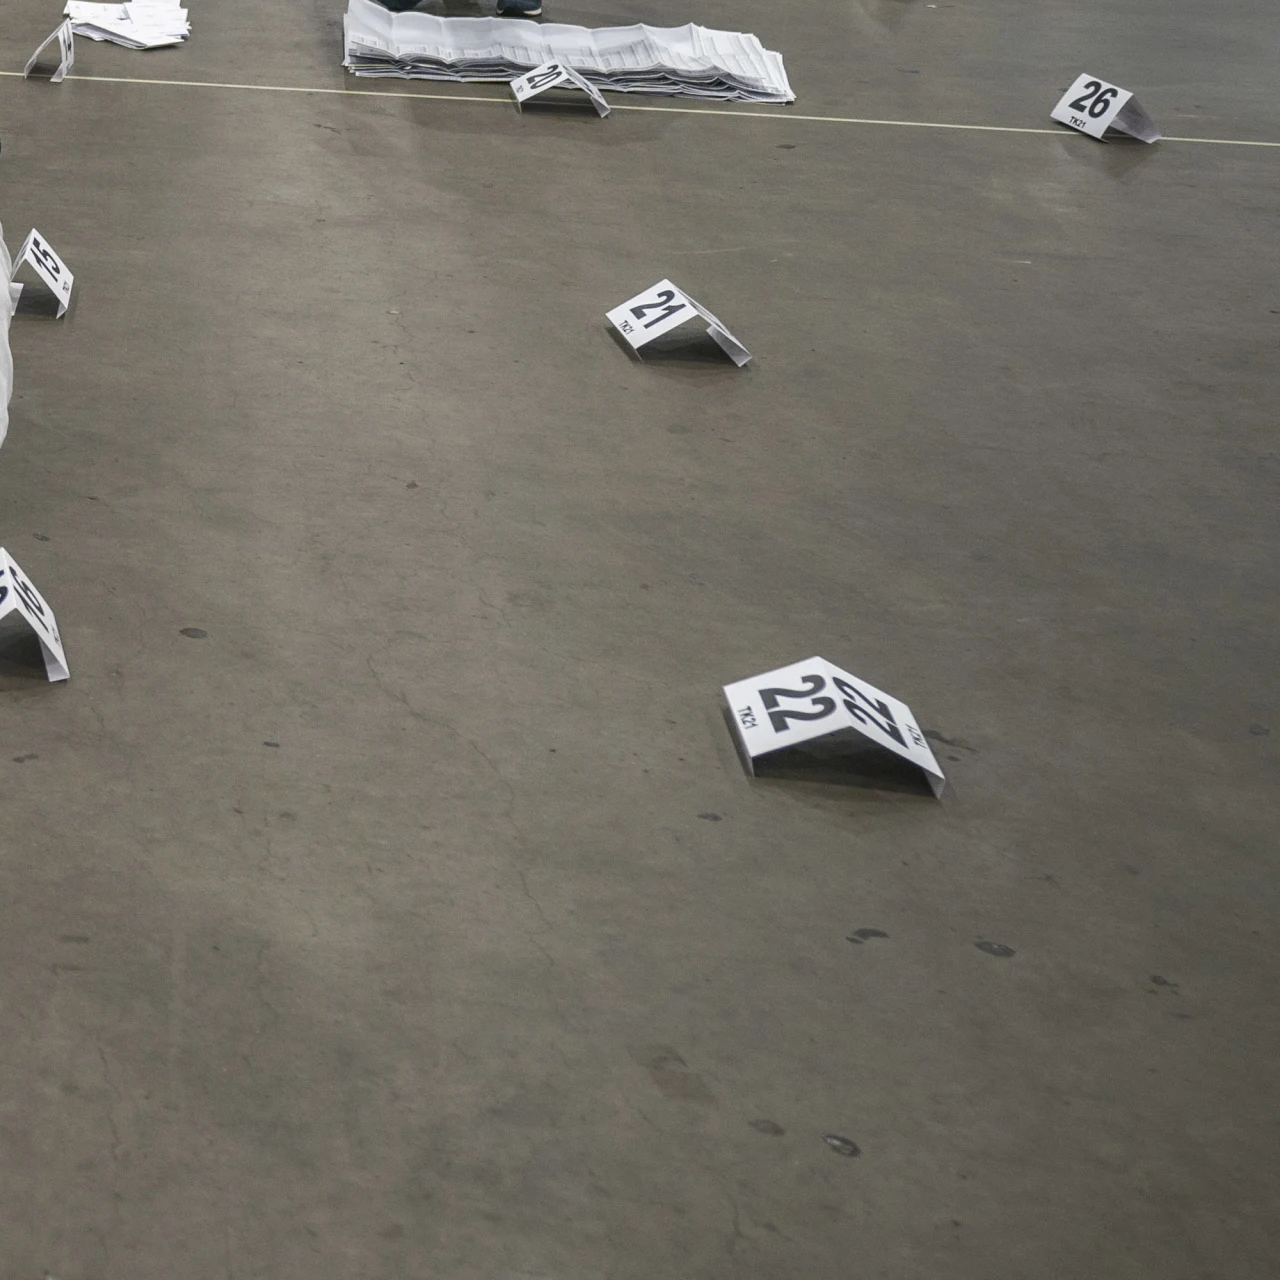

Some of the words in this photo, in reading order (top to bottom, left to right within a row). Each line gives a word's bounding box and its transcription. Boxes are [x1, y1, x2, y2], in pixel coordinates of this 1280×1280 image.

[525, 63, 563, 90] 20
[1067, 80, 1119, 119] 26
[1068, 115, 1087, 129] TK21
[29, 236, 61, 283] 15
[618, 318, 635, 335] TK21
[628, 289, 688, 330] 21
[737, 705, 759, 730] TK21
[758, 674, 837, 734] 22
[831, 676, 909, 750] 22
